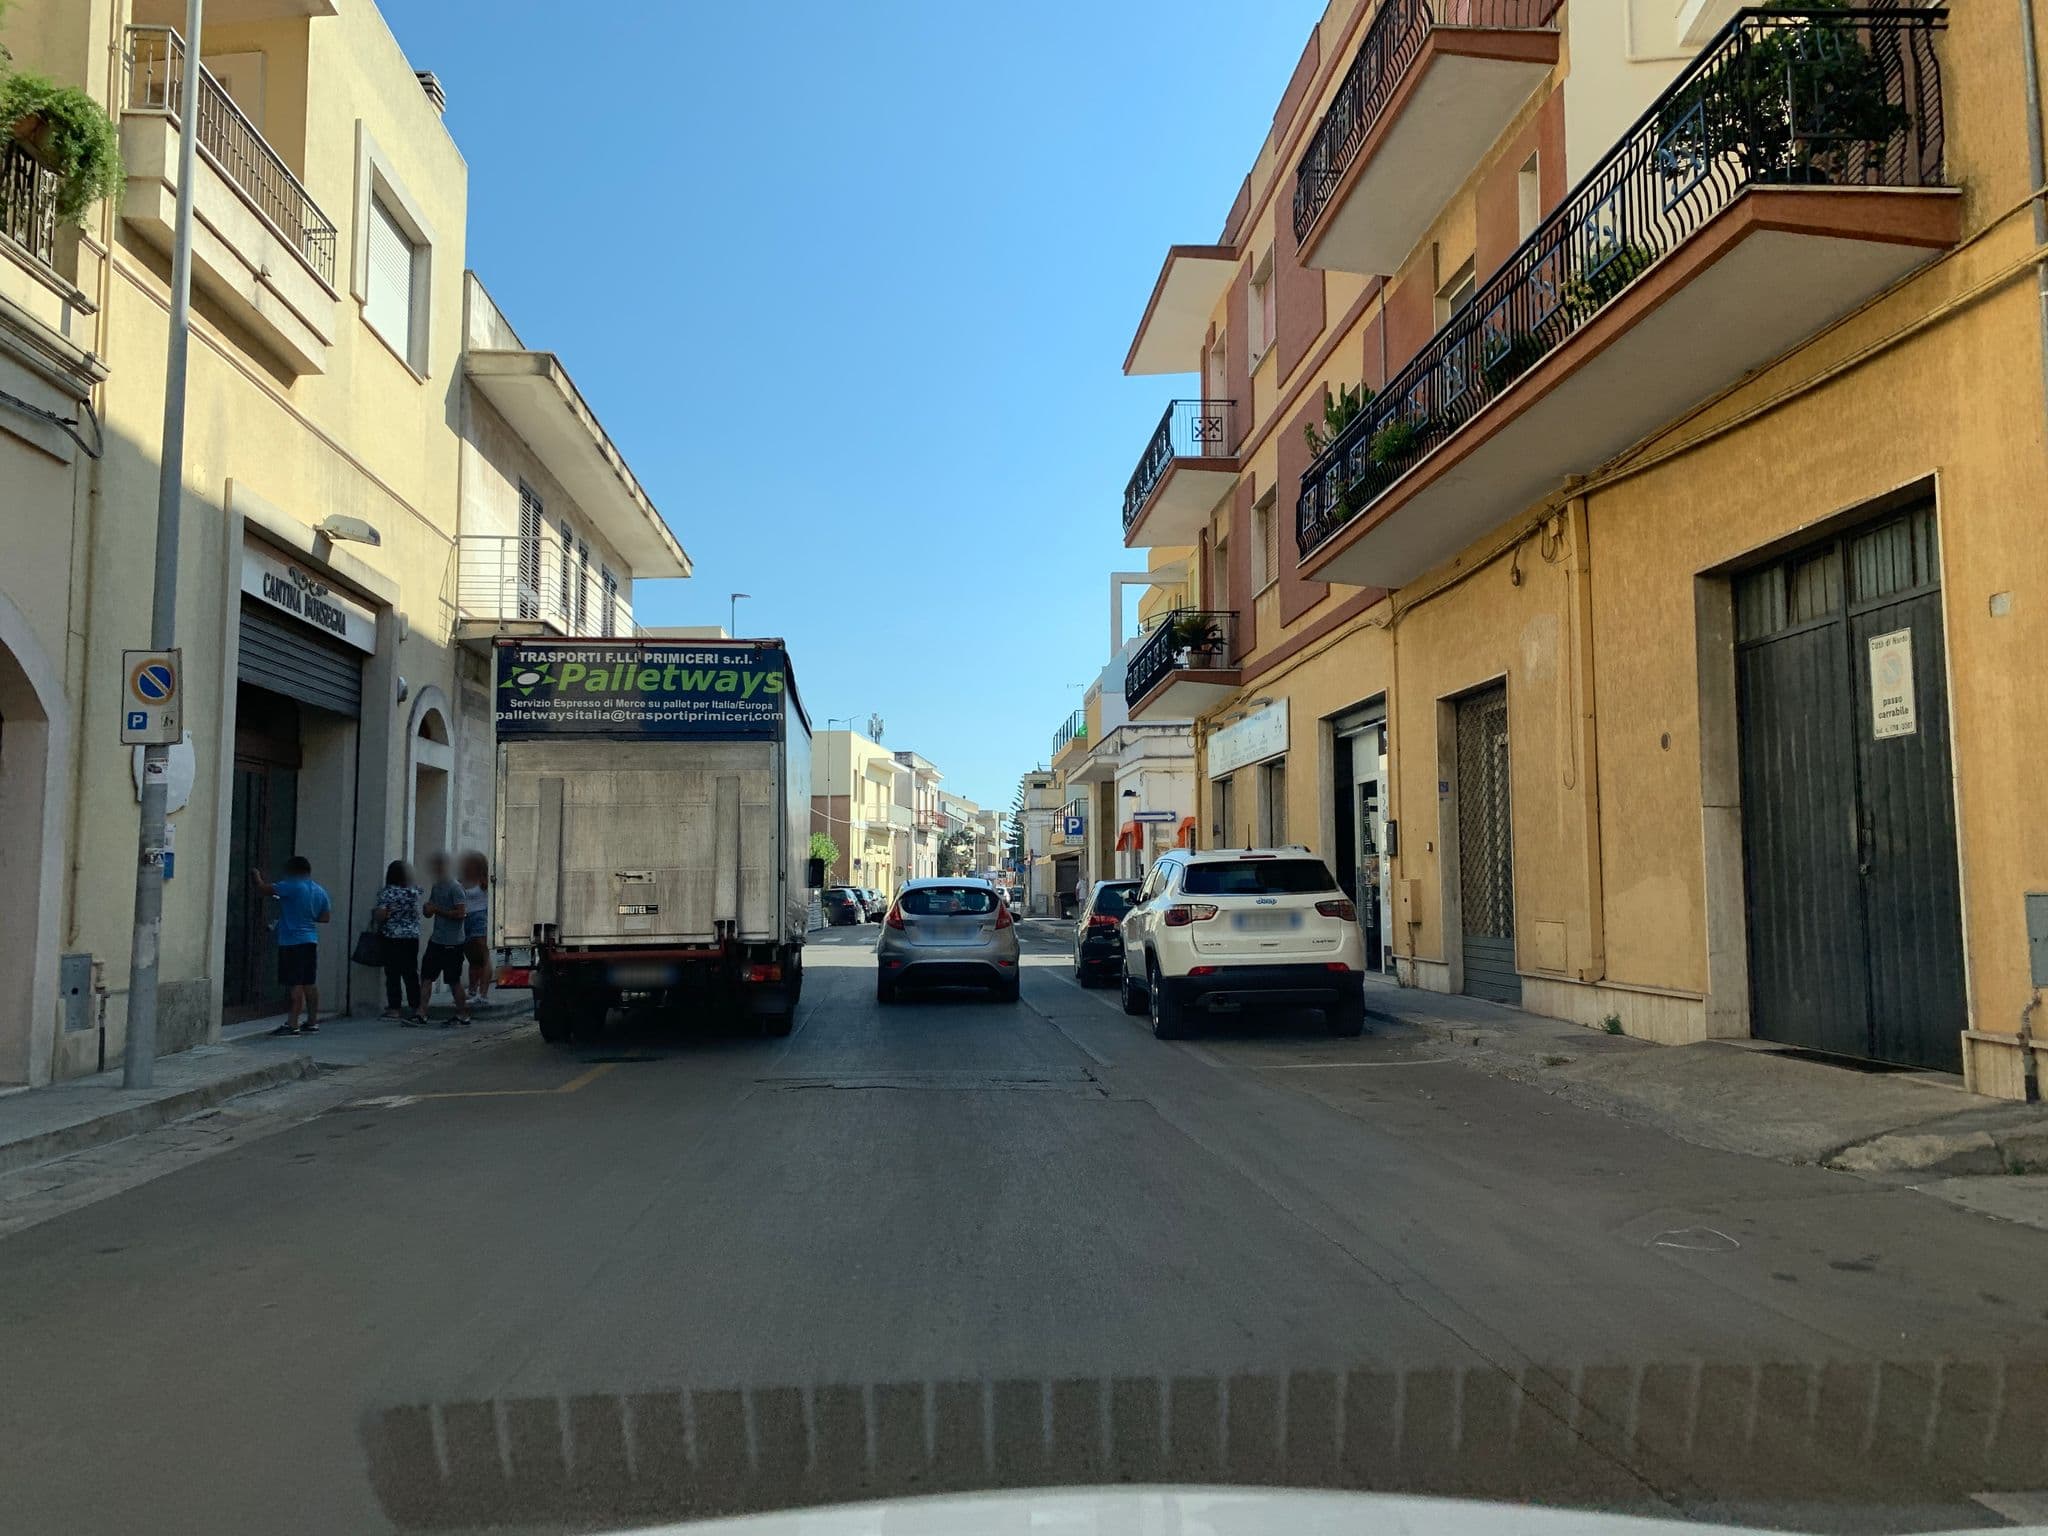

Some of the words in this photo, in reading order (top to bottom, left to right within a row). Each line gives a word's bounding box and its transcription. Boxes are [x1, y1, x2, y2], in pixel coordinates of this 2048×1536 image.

[263, 572, 302, 614] CANTINA
[520, 652, 600, 662] TRASPORTI
[644, 653, 718, 664] PRIMICERI
[723, 655, 752, 664] s.r.l.
[558, 663, 784, 699] Palletways
[510, 699, 551, 708] Servizio
[553, 699, 600, 709] Espresso
[603, 699, 613, 708] di
[615, 699, 646, 708] Merce
[663, 700, 690, 709] pallet
[693, 702, 709, 710] per
[712, 701, 773, 711] Italia/Europa
[1883, 696, 1903, 707] passo
[496, 710, 784, 722] palletwaysitalia@trasportiprimiceri.com
[1878, 706, 1909, 719] carrabile
[132, 715, 144, 728] P
[1068, 818, 1080, 834] P
